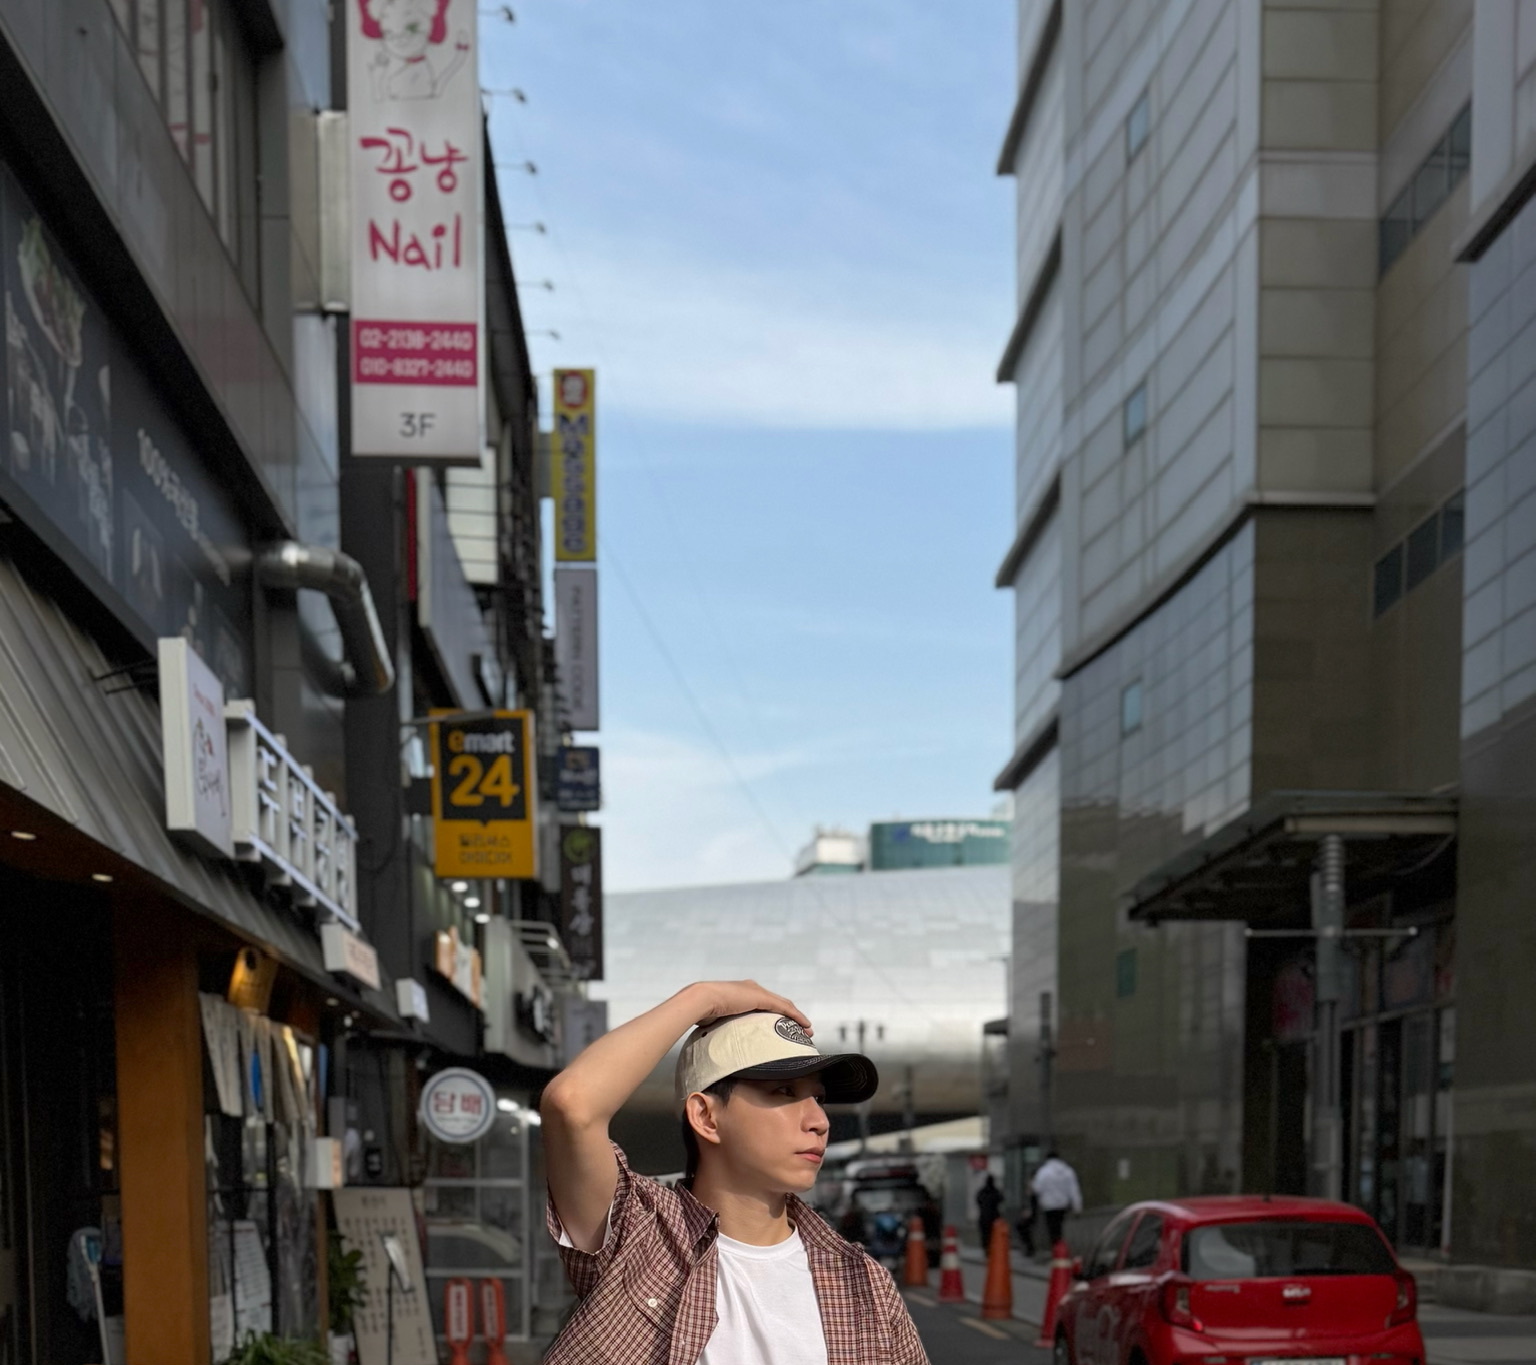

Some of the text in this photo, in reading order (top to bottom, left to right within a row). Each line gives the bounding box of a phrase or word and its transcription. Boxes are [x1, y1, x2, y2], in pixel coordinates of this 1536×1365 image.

[359, 127, 468, 202] 꽁냥
[368, 212, 462, 271] Nail
[400, 413, 436, 437] 3F
[448, 731, 515, 753] emart
[449, 754, 520, 808] 24
